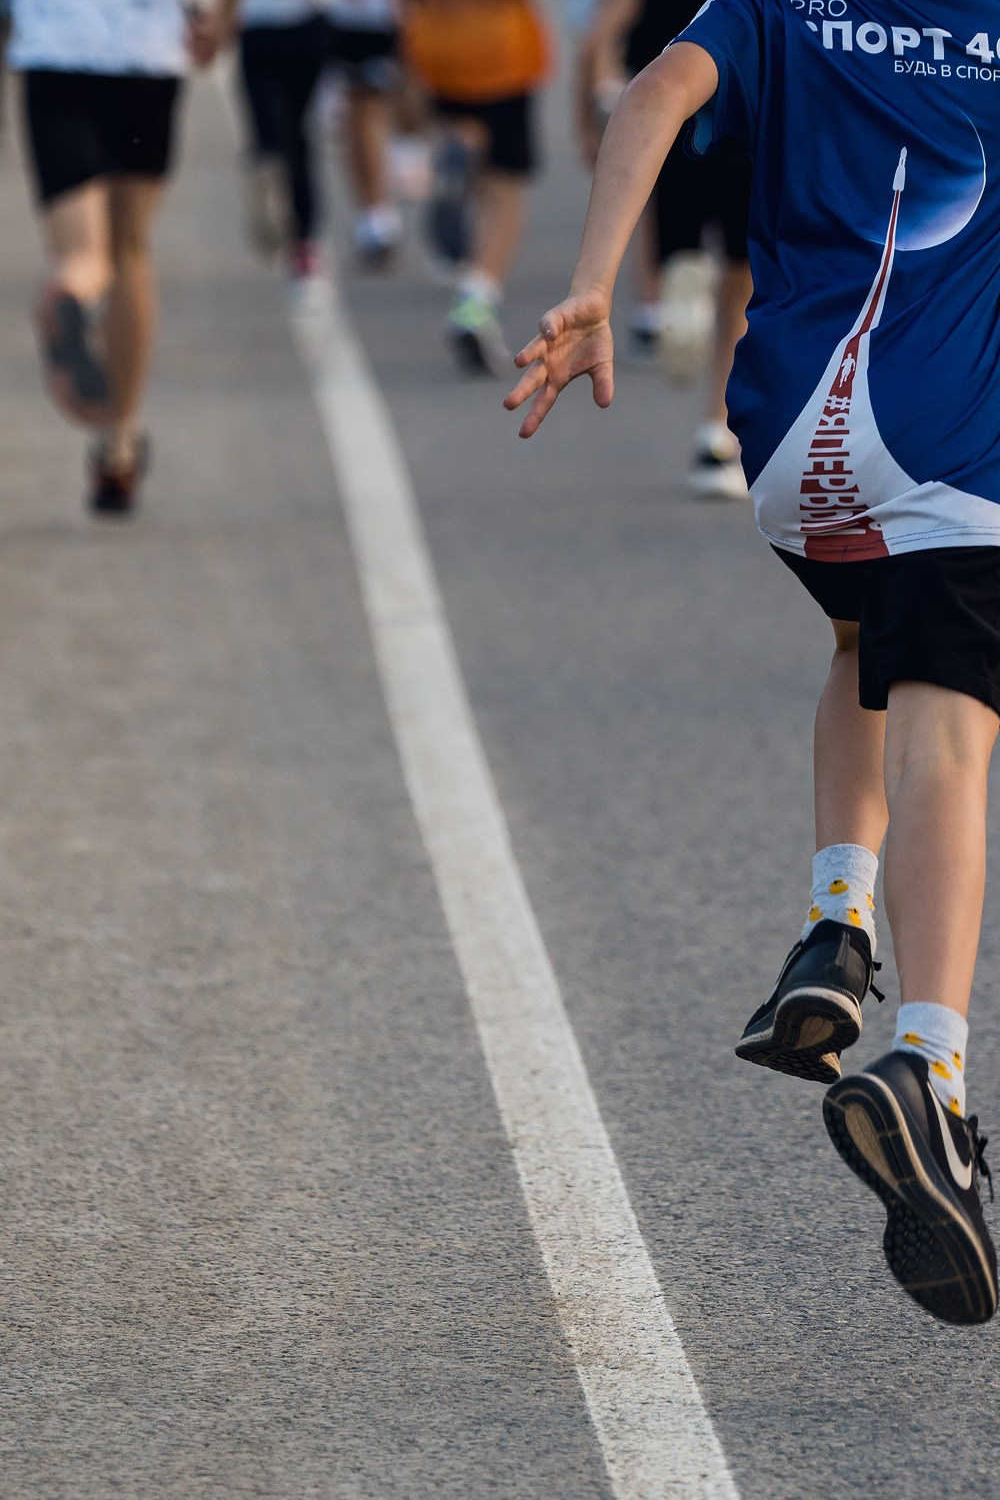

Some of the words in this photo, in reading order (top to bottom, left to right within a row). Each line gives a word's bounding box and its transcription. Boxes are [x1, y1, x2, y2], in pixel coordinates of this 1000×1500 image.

[805, 20, 953, 61] ПОРТ
[894, 59, 937, 77] БУДЬ
[941, 64, 952, 78] В
